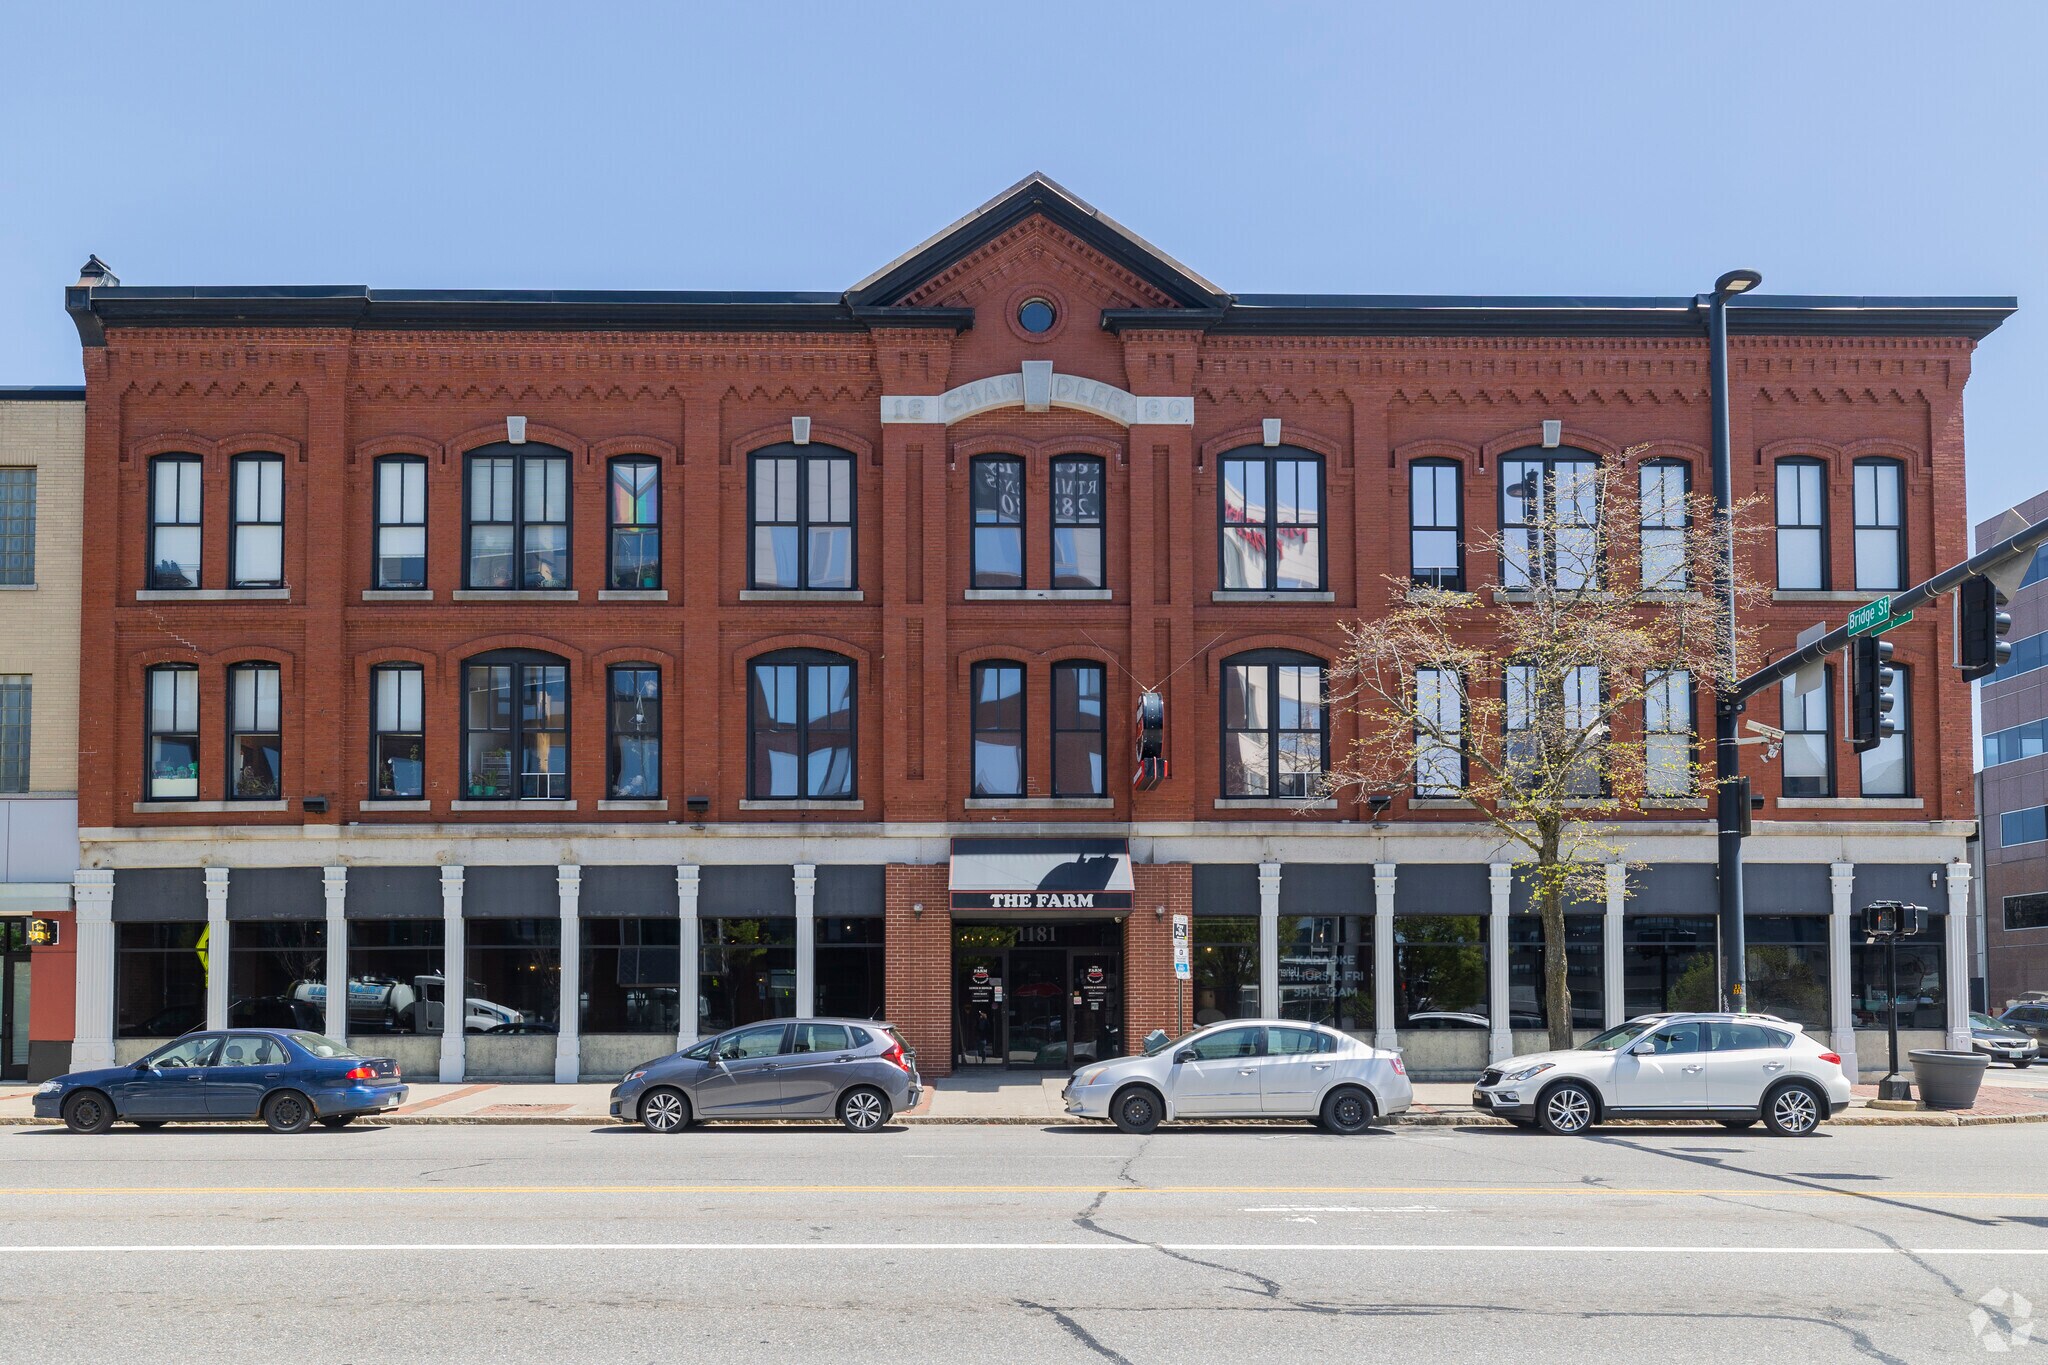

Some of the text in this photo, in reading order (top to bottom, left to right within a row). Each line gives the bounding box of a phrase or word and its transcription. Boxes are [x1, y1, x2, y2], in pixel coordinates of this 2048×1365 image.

[893, 399, 925, 419] 18
[1145, 399, 1187, 419] 80
[1849, 607, 1875, 629] Bridge
[1878, 599, 1887, 616] St
[990, 893, 1094, 908] THE FARM
[1018, 926, 1057, 942] 1181
[1295, 955, 1356, 965] KARAOKE
[1344, 971, 1364, 981] FRI
[1294, 987, 1358, 998] 9PM-12AM
